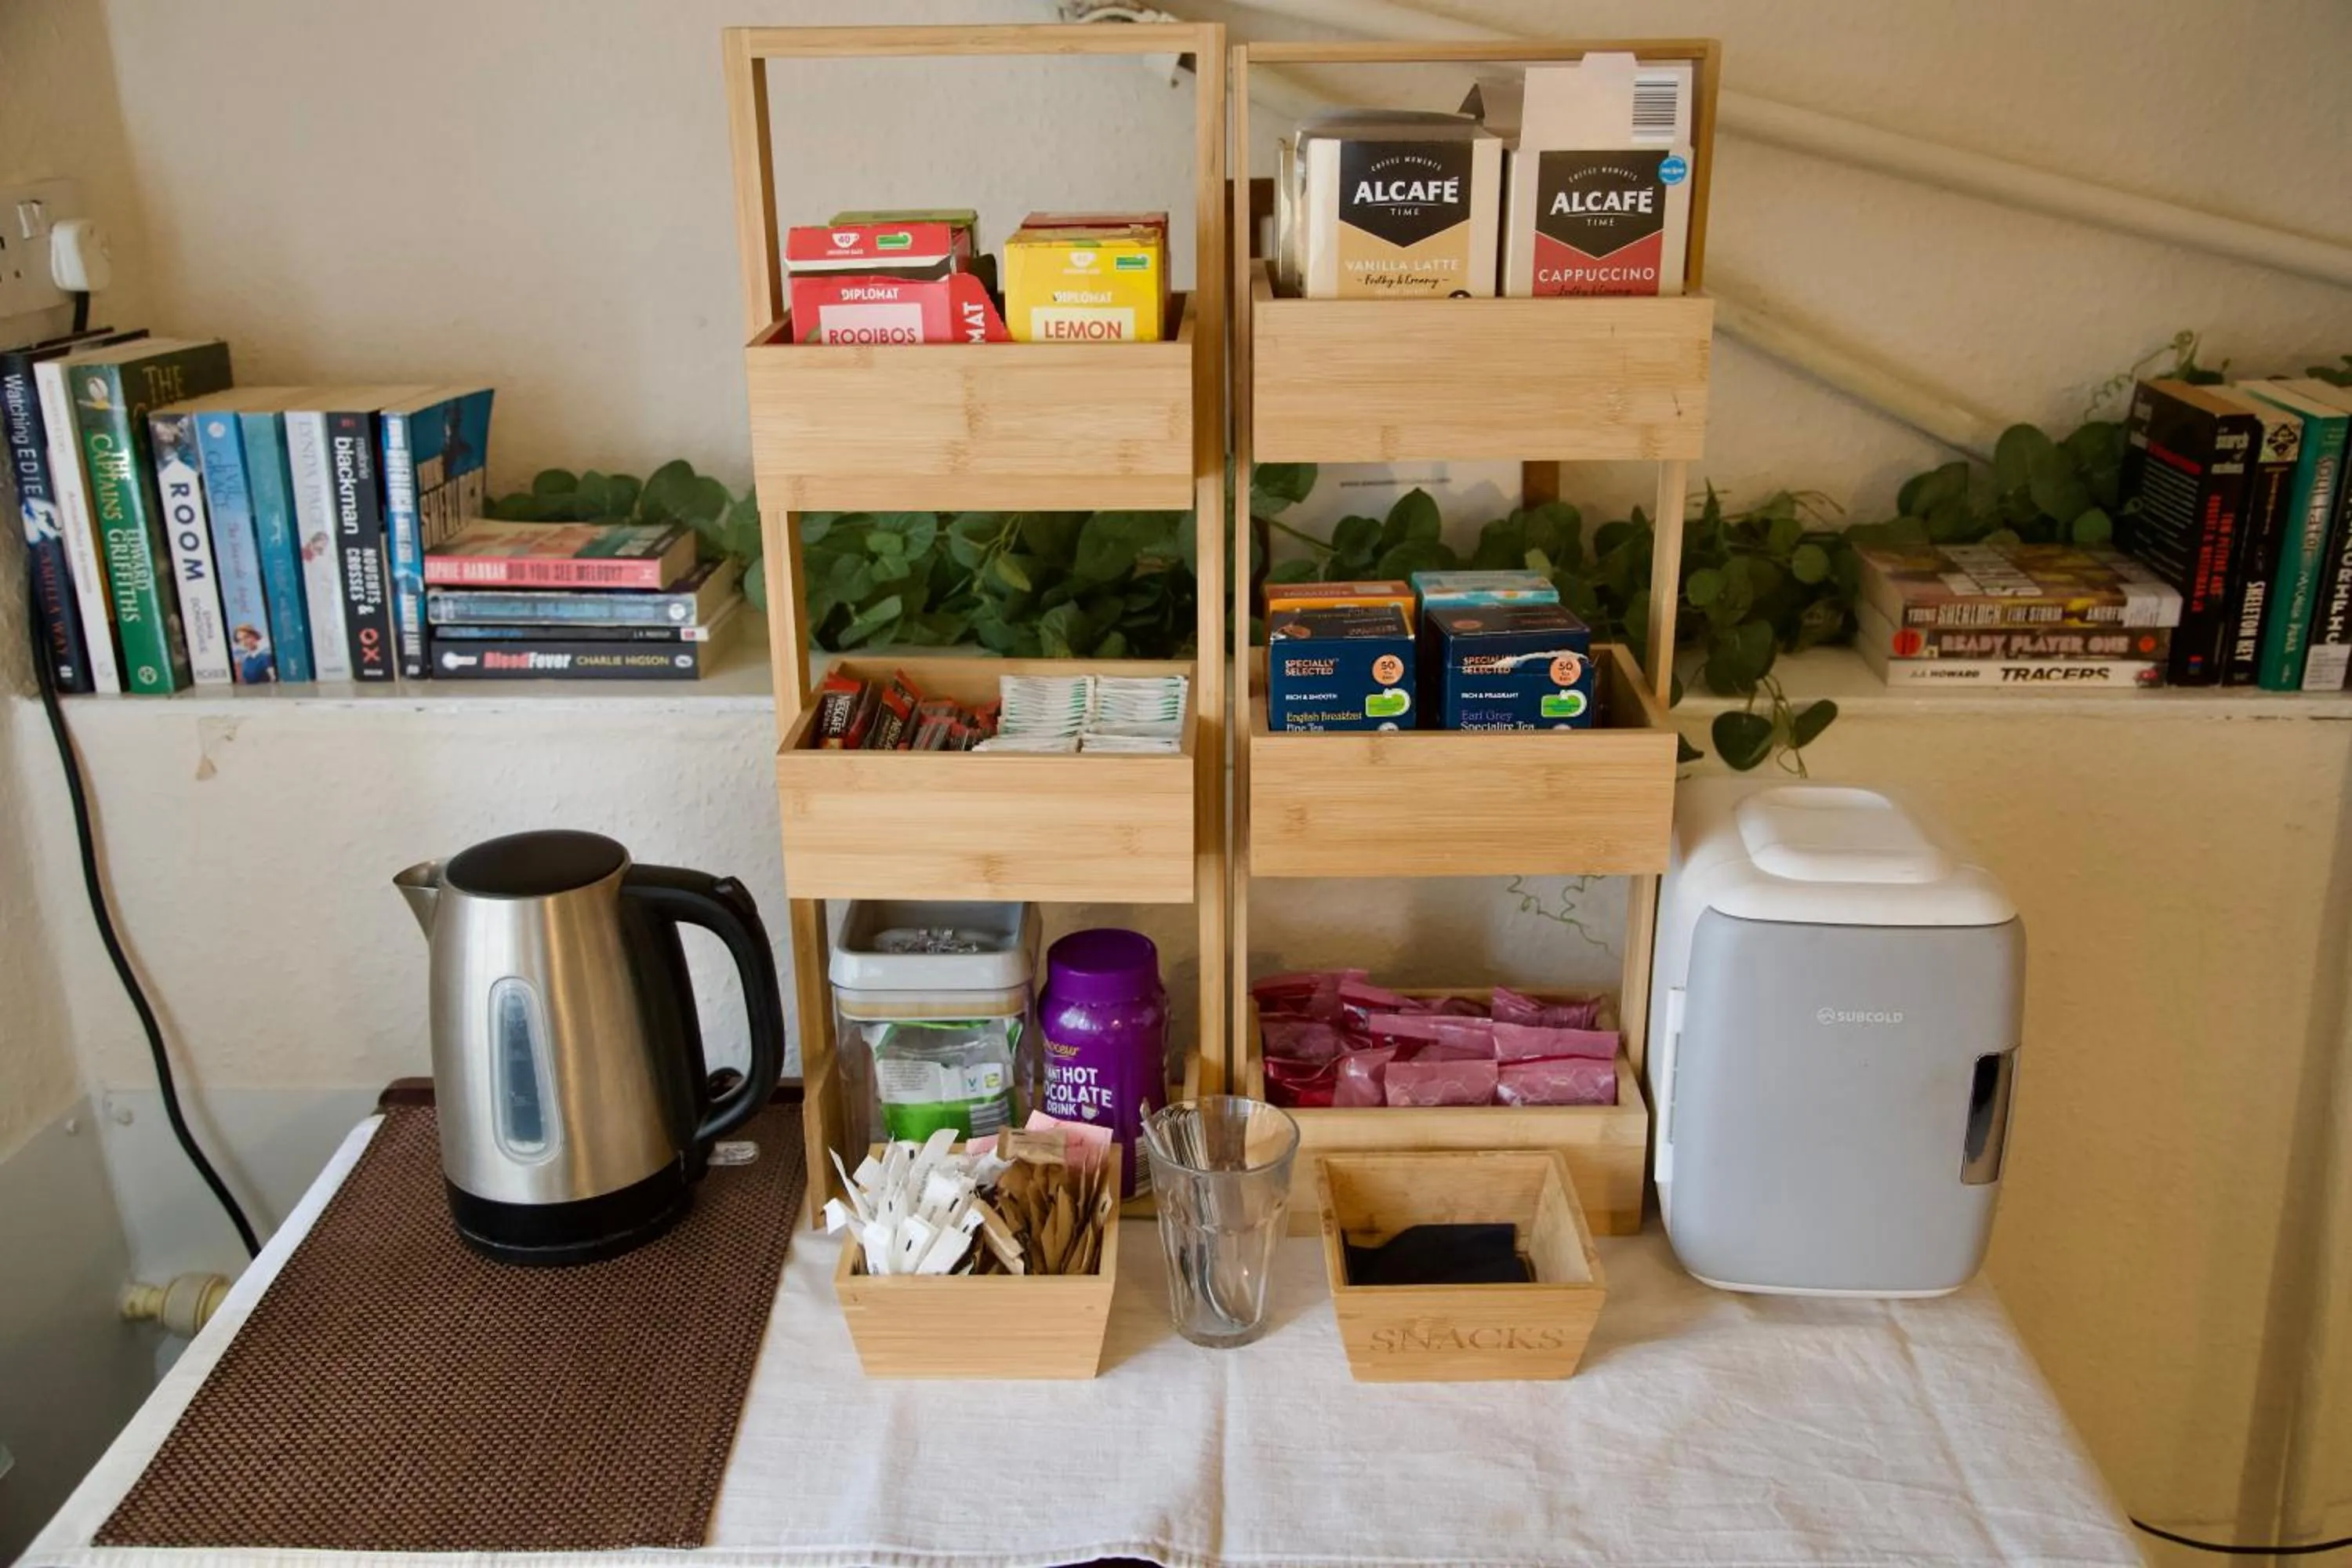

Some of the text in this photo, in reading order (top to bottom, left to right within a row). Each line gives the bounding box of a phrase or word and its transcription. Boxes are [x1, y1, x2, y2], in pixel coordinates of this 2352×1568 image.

[1352, 176, 1459, 205] ALCAFÉ
[1549, 186, 1654, 216] ALCAFÉ
[1586, 218, 1615, 227] TIME
[1345, 259, 1460, 271] VANILLA LATTE
[1538, 267, 1655, 282] CAPPUCCINO
[840, 289, 898, 301] DIPLOMAT
[1054, 292, 1112, 303] DIPLOMAT
[829, 328, 916, 343] ROOIBOS
[1044, 321, 1122, 339] LEMON
[4, 374, 42, 495] Watching EDIE
[112, 448, 132, 481] THE
[91, 433, 124, 519] CAPTAINS
[335, 437, 358, 535] blackman
[170, 481, 205, 580] ROOM
[126, 528, 151, 590] EDWARD
[107, 528, 141, 622] GRIFFITHS
[347, 548, 364, 601] CROSSES
[358, 548, 380, 615] NOUGHTS &
[1937, 604, 2000, 626] SHERLOCK
[2085, 606, 2125, 621] ANDRE
[2234, 581, 2266, 662] SKELETON KEY
[51, 623, 70, 656] WAY
[1941, 635, 2129, 654] READY PLAYER ONE
[576, 655, 622, 666] CHARLIE
[626, 655, 670, 666] HIGSON
[1381, 661, 1395, 670] 50
[1559, 662, 1573, 670] 50
[1285, 667, 1333, 677] SELECTED
[1929, 670, 1980, 679] HOWARD
[2001, 667, 2110, 683] TRACERS
[1287, 711, 1362, 724] English Breakfast
[1461, 710, 1513, 722] Earl Grey
[1516, 721, 1535, 731] Tea
[1837, 1011, 1904, 1023] SUBCOLD
[1062, 1067, 1098, 1085] HOT
[1044, 1080, 1113, 1108] OCOLATE
[1047, 1100, 1077, 1116] DRINK
[1370, 1327, 1565, 1354] SNACKS
